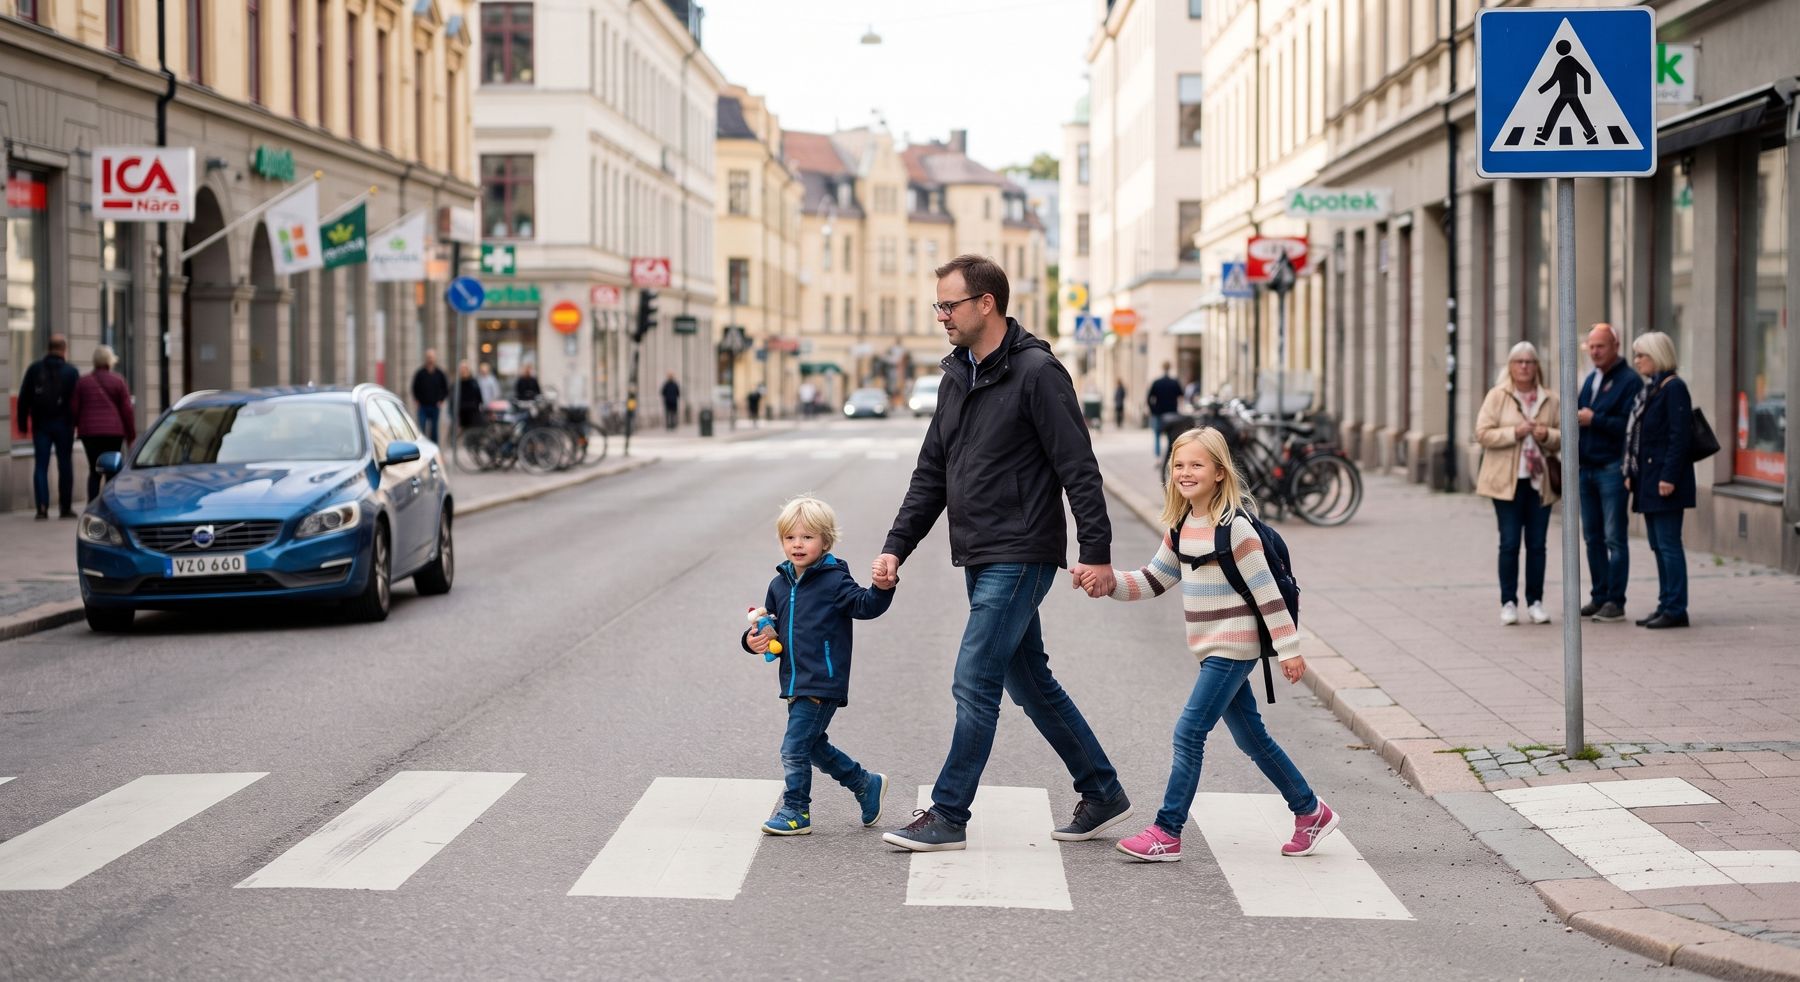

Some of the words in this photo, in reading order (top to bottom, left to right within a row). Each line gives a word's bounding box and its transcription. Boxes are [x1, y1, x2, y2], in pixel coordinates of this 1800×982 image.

[102, 157, 176, 194] ICA
[1291, 191, 1378, 213] Apotek
[211, 557, 241, 572] 660
